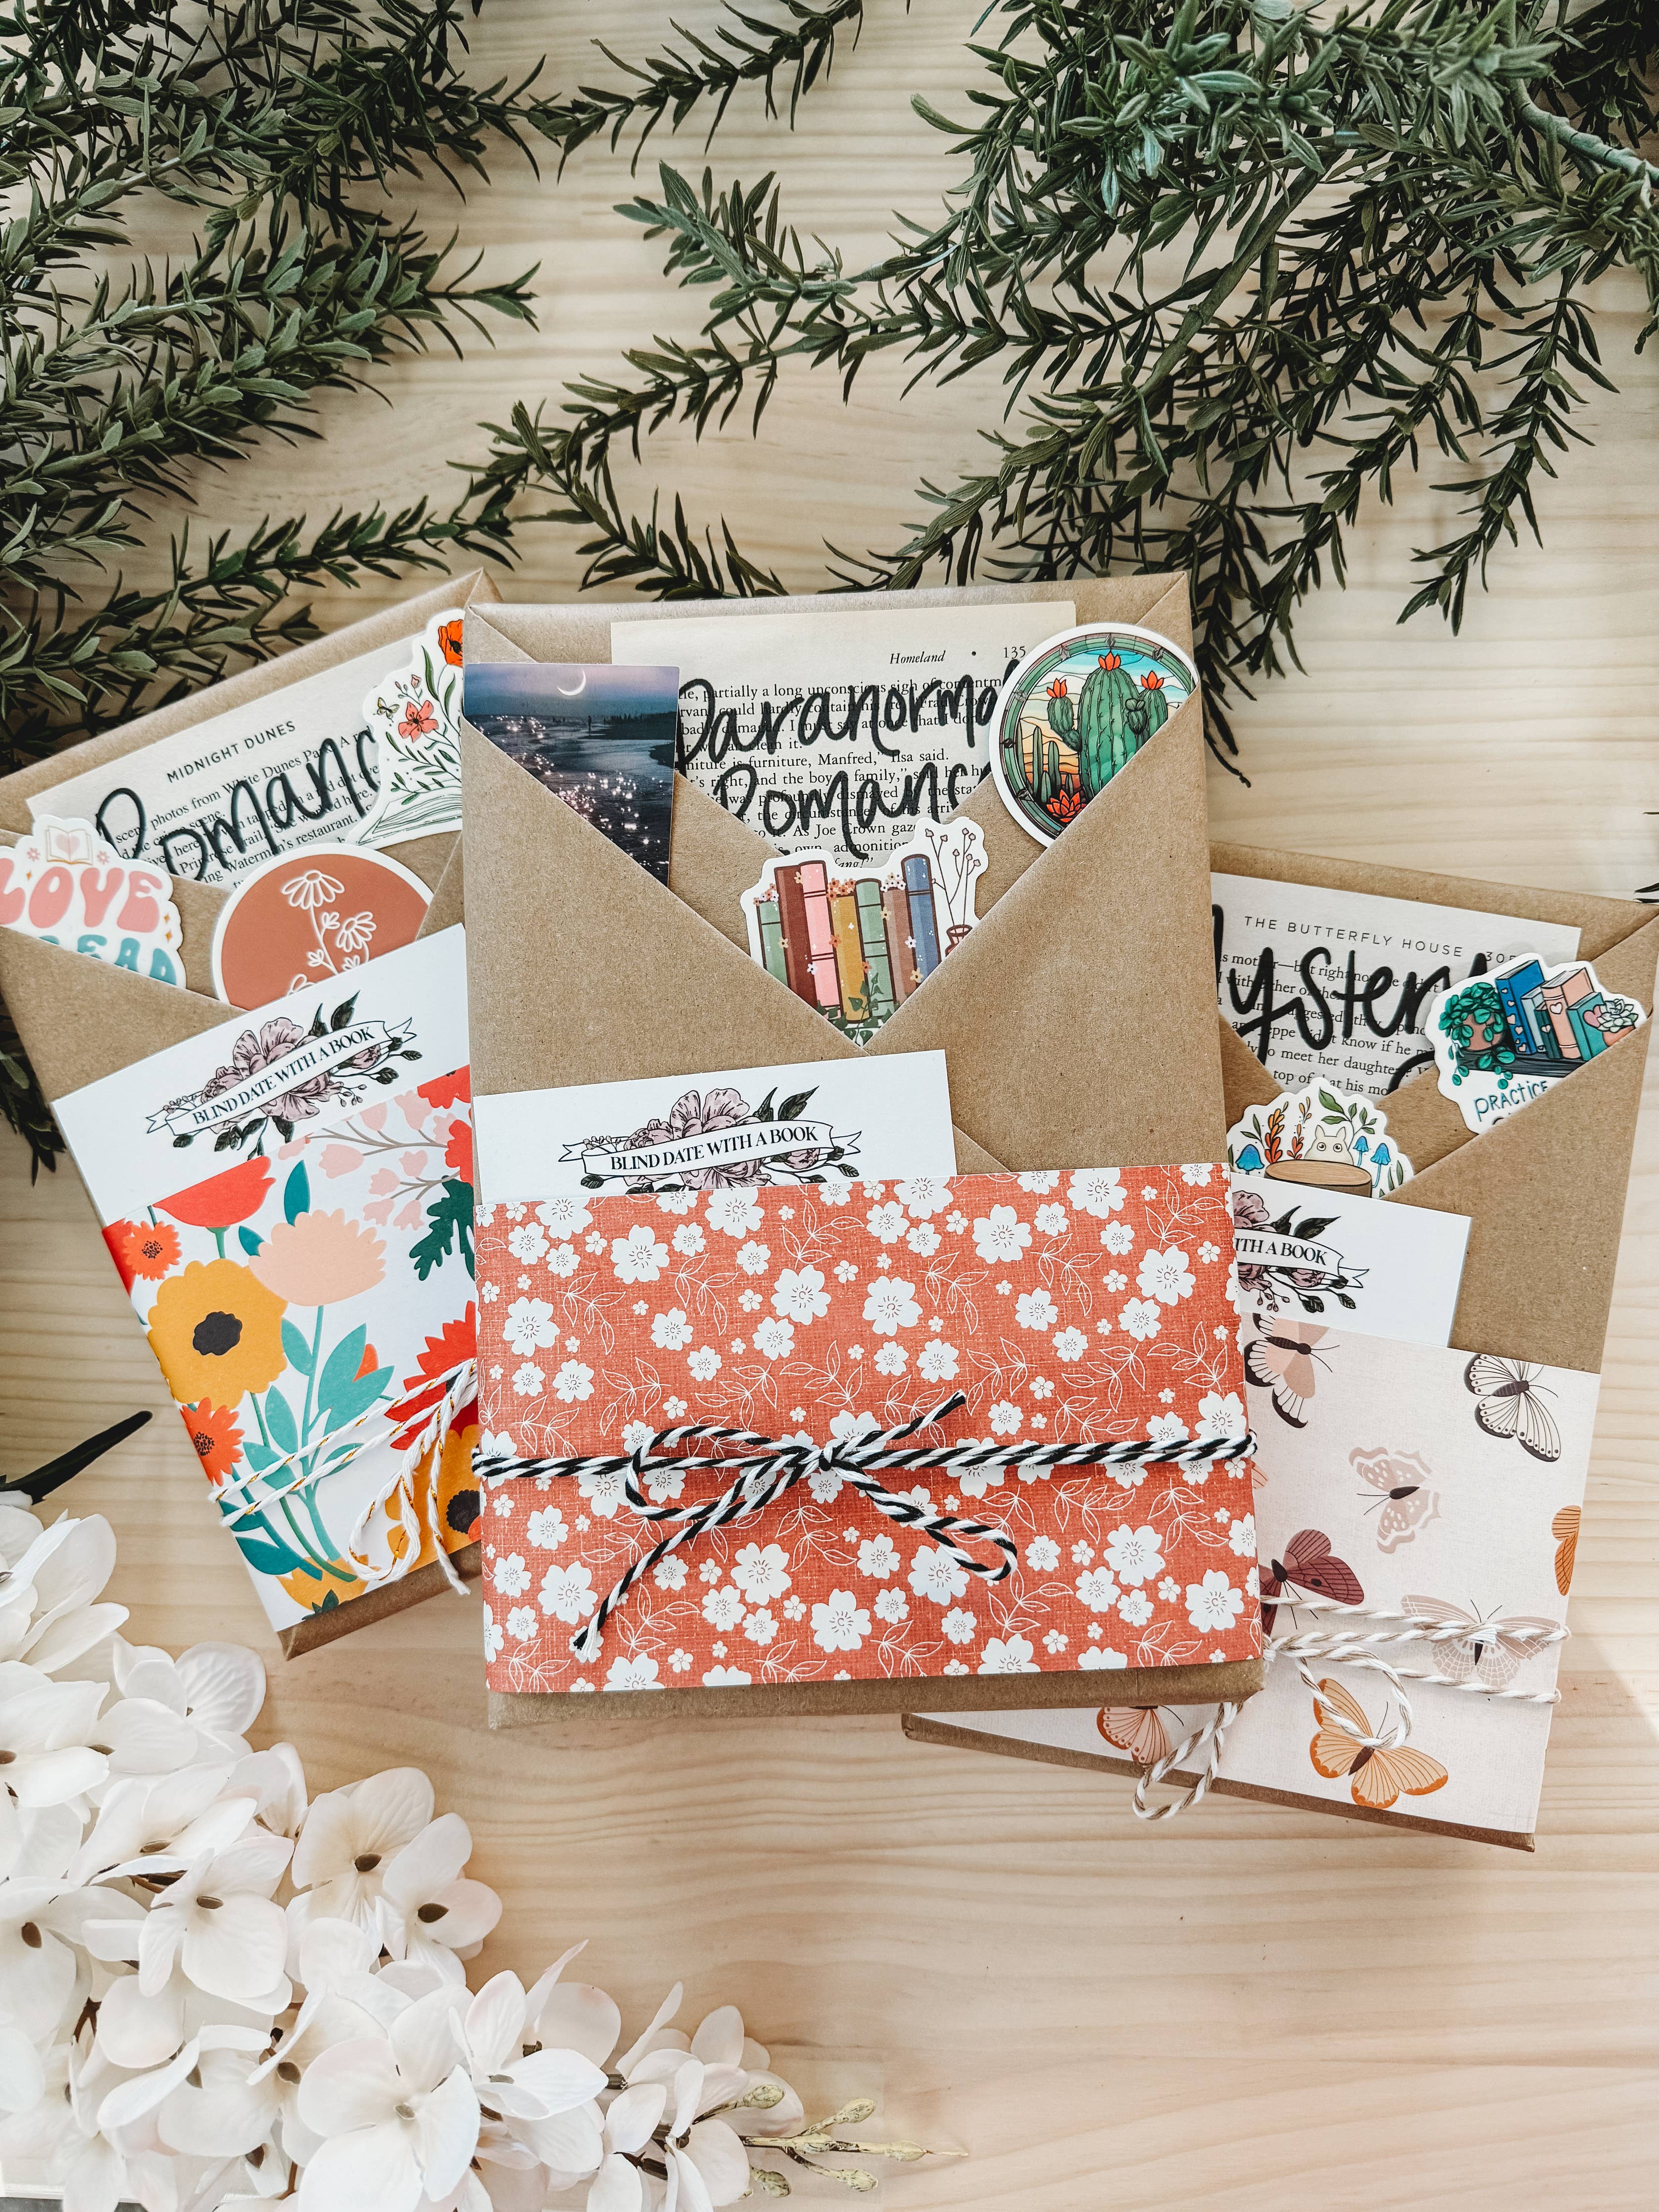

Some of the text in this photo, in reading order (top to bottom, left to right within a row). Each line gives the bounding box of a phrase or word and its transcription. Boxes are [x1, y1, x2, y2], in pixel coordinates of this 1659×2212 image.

[890, 646, 1026, 665] Homeland 135
[704, 685, 758, 702] prtially
[762, 688, 770, 696] a
[774, 684, 802, 699] long
[676, 659, 1020, 779] Paranorma
[790, 720, 795, 732] I
[915, 714, 939, 726] hat
[167, 721, 296, 783] MIDNIGHT DUNES
[789, 737, 802, 748] it.
[748, 755, 812, 768] furniture,
[919, 748, 949, 761] said.
[116, 825, 144, 843] scen
[151, 805, 190, 830] photos
[191, 790, 222, 810] from
[262, 758, 302, 779] Dunes
[340, 736, 351, 748] A
[755, 773, 777, 785] nd
[783, 772, 804, 784] the
[809, 770, 832, 786] boy
[95, 728, 381, 880] Romanc
[306, 791, 315, 801] a
[729, 795, 752, 805] wa
[759, 788, 828, 807] profounly
[713, 762, 992, 860] Romanc
[296, 814, 358, 845] restaurant.
[792, 825, 810, 836] As
[814, 824, 836, 840] Joe
[891, 823, 916, 836] gaz
[0, 858, 163, 933] LOVE
[1244, 916, 1278, 930] THE
[1288, 922, 1392, 946] BUTTERFLY
[1402, 938, 1463, 957] HOUSE
[1319, 964, 1349, 981] righ
[1341, 1036, 1378, 1050] know
[1381, 1040, 1394, 1052] if
[1396, 1042, 1411, 1055] he
[1281, 1050, 1313, 1062] meet
[1317, 1052, 1339, 1066] her
[192, 1026, 375, 1125] BLIND DATE WITH A BOOK
[1273, 1070, 1294, 1085] top
[1298, 1072, 1315, 1084] of
[1345, 1078, 1364, 1092] his
[1368, 1085, 1389, 1096] mo
[610, 1126, 819, 1170] BLIND DATE WITH A BOOK
[1235, 1238, 1328, 1266] ITH A BOOK
